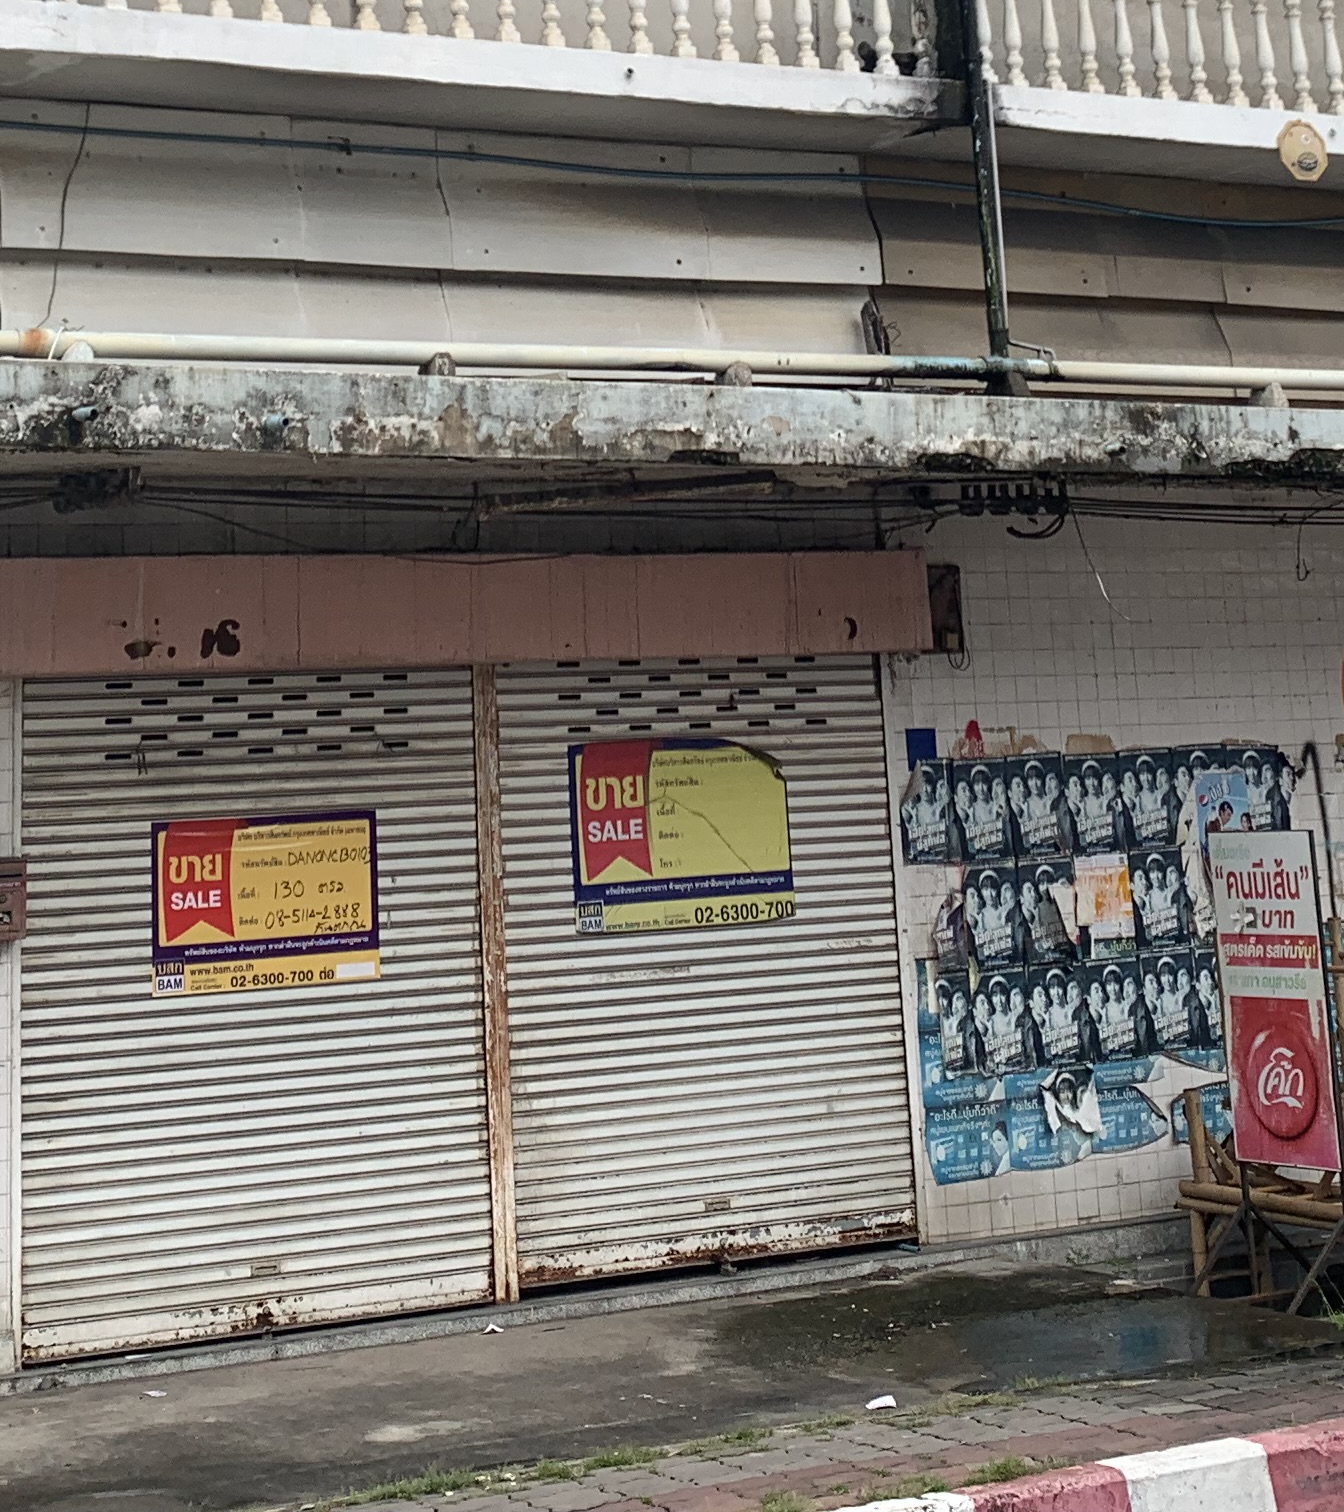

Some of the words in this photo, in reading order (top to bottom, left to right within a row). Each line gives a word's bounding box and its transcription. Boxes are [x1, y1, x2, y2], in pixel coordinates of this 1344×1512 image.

[586, 775, 645, 811] ขาย
[587, 818, 644, 843] SALE
[168, 853, 223, 884] ขาย
[170, 890, 222, 910] SALE
[274, 879, 305, 900] 130
[694, 900, 795, 924] 02-6300-700
[1262, 908, 1295, 929] บาท
[581, 918, 602, 931] BAM
[189, 964, 254, 977] www.bam.co.th
[230, 969, 314, 988] 02-6300-700
[319, 965, 335, 980] ต่อ
[157, 977, 183, 991] BAM
